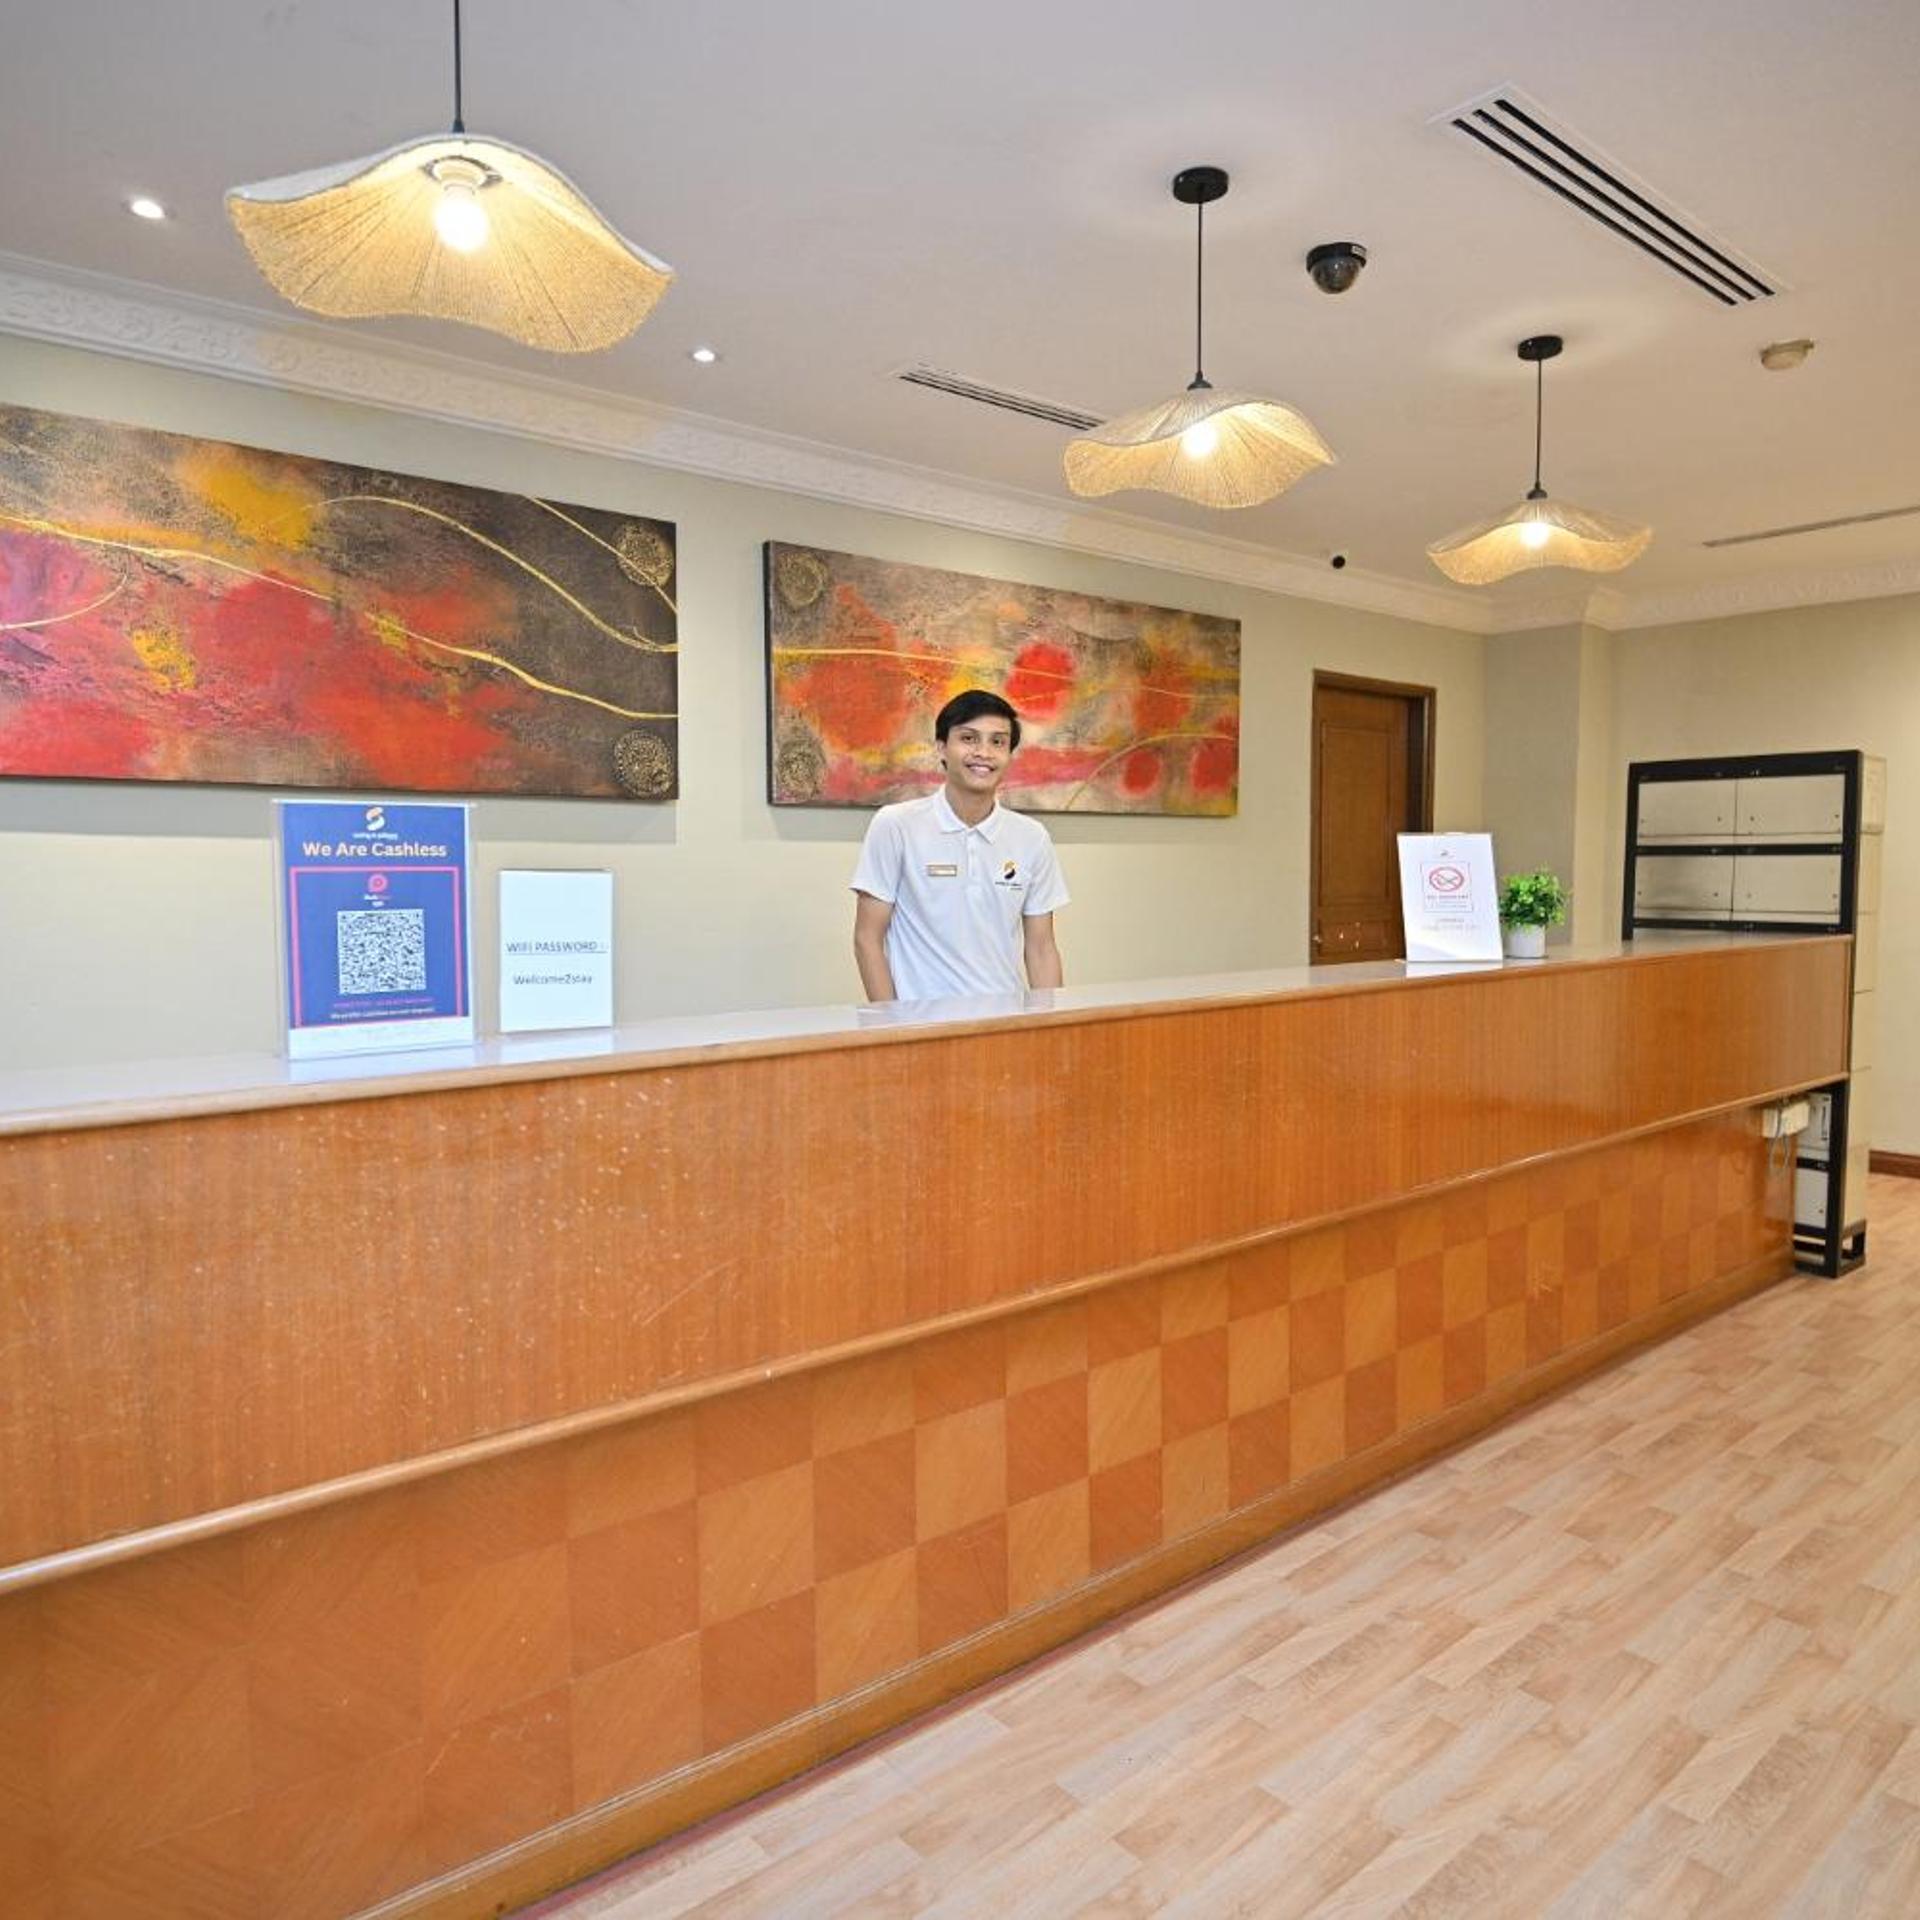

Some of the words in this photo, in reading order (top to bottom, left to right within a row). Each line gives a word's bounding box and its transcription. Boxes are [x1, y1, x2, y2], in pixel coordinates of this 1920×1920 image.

[302, 842, 331, 857] We
[336, 842, 367, 857] Are
[372, 841, 447, 857] Cashless
[535, 940, 598, 953] PASSWORD
